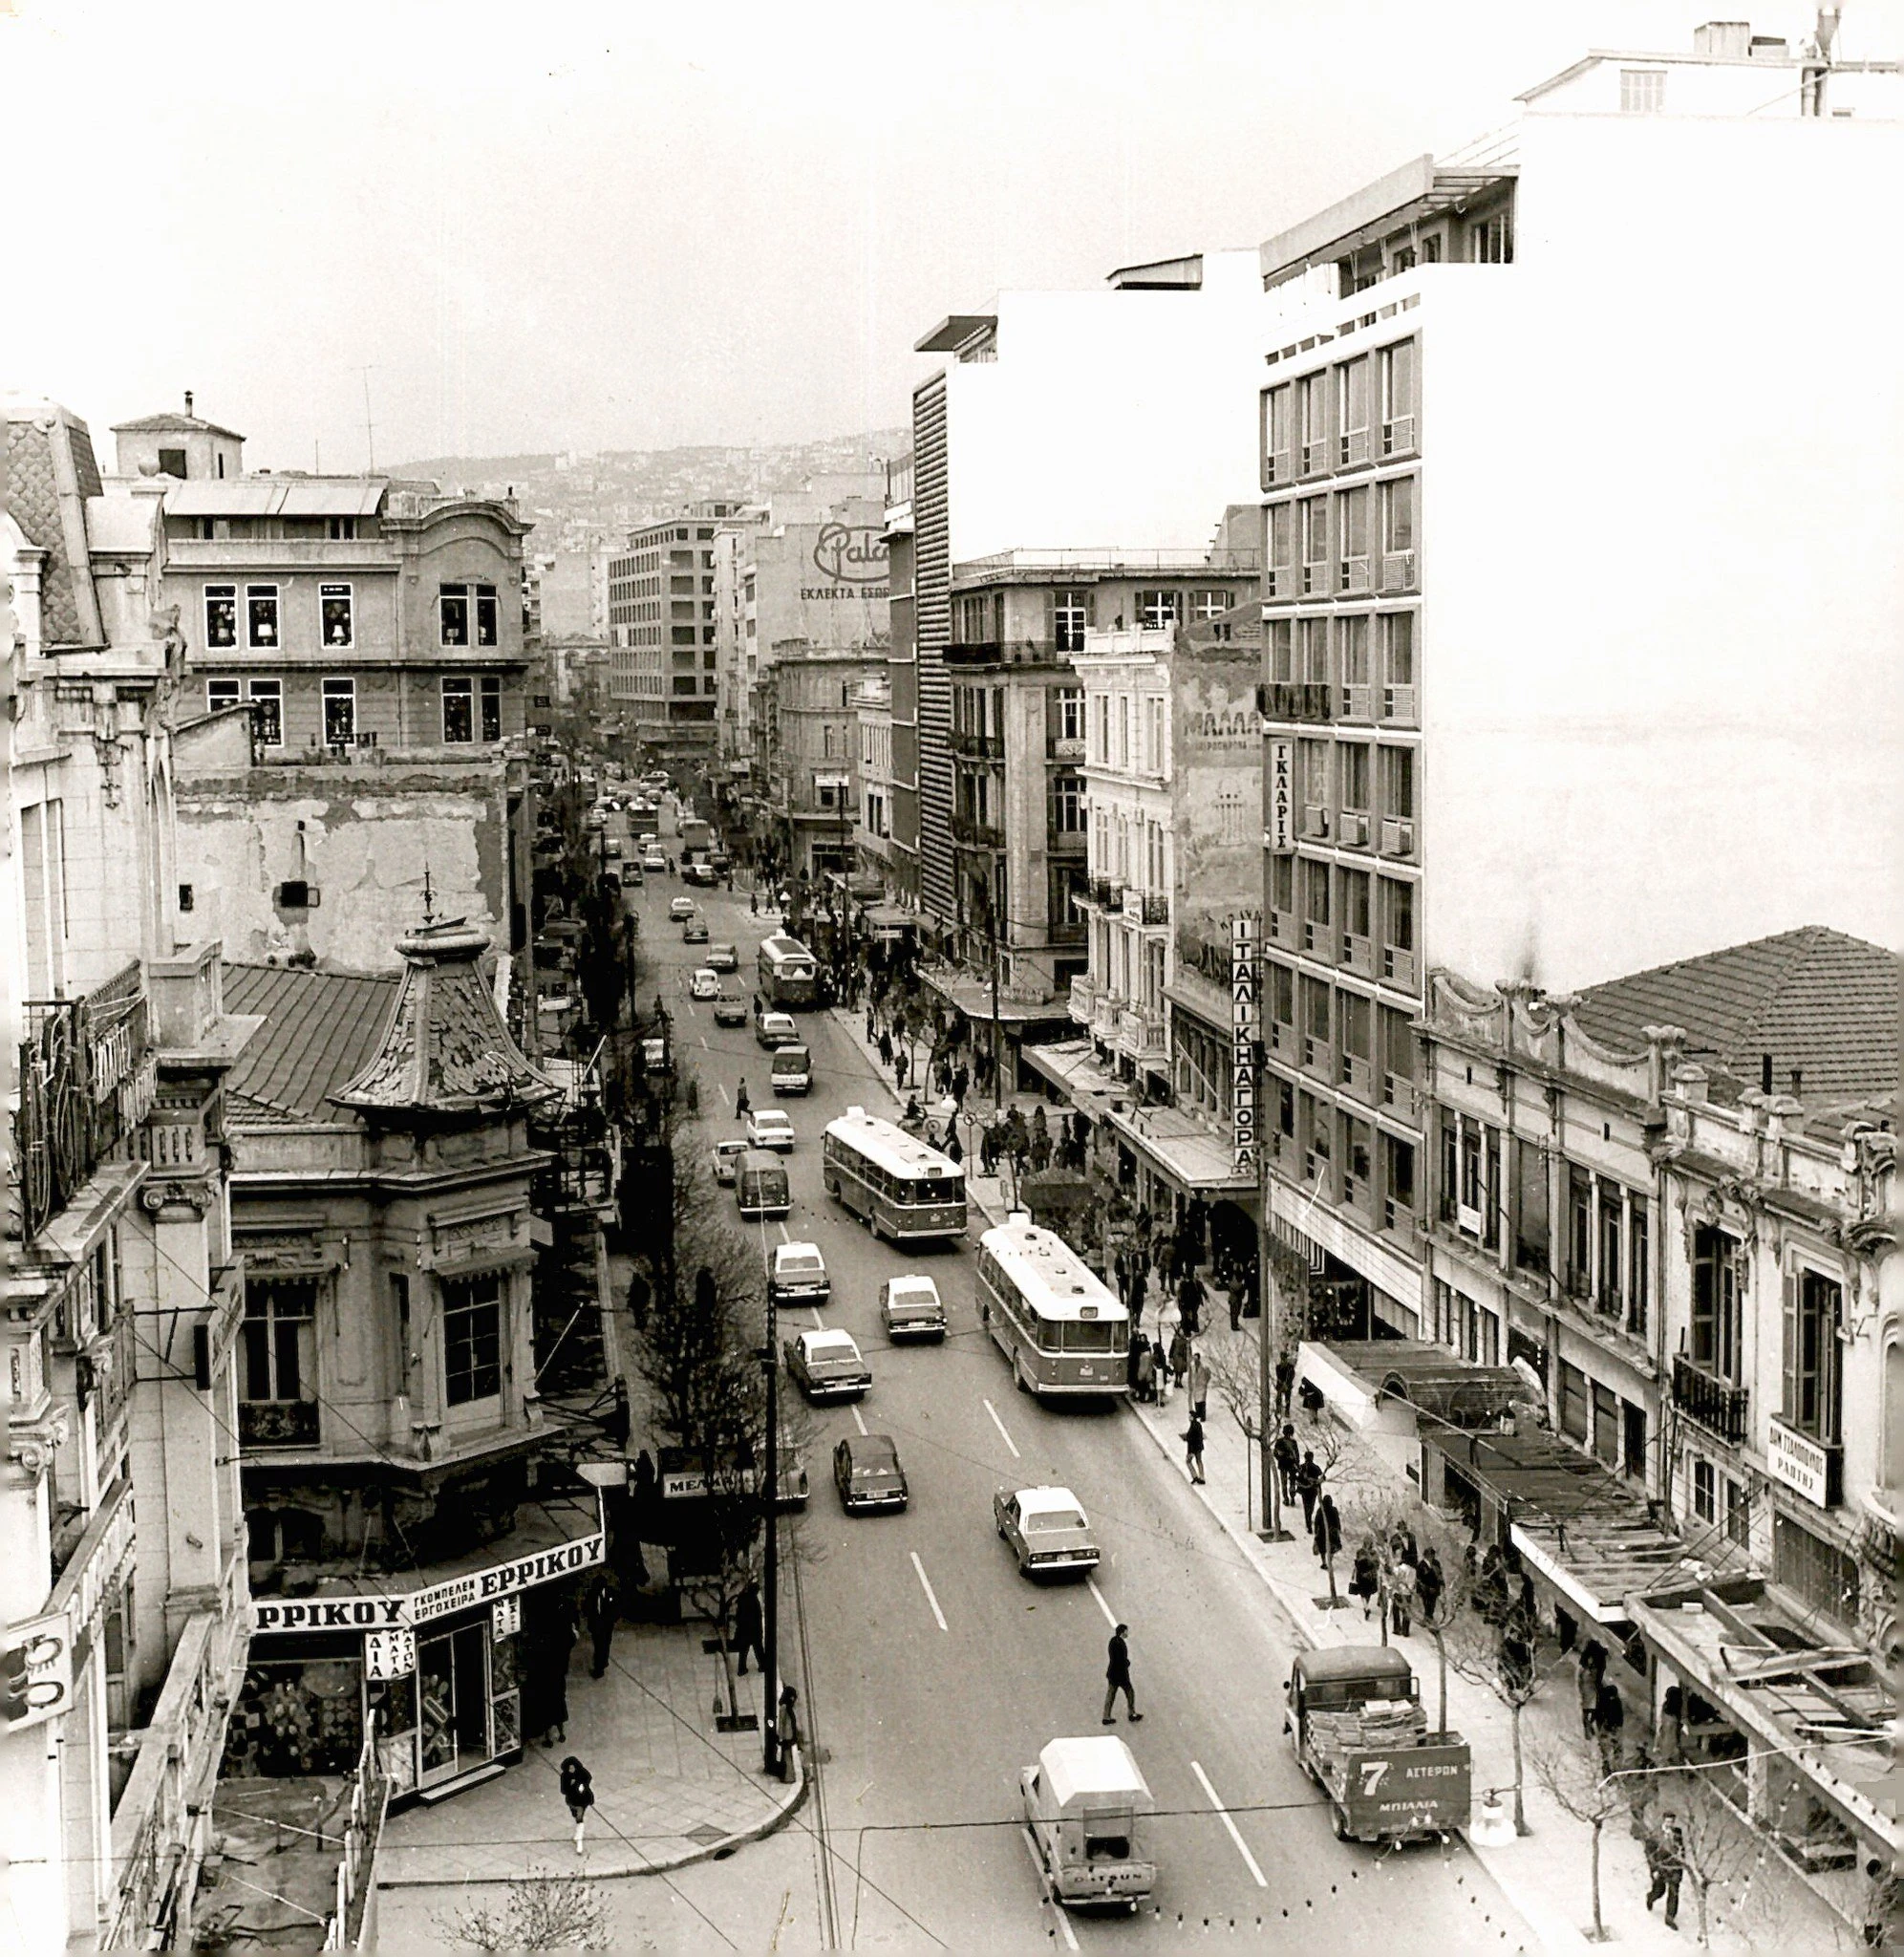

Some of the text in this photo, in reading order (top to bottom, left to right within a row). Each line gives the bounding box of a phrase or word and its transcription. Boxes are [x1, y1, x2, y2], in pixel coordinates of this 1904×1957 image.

[801, 587, 855, 600] ΕΚΛΕΚΤΑ
[1275, 745, 1288, 849] ΓΚΛΑΡΙΣ
[1235, 922, 1252, 1165] ΙΤΑΛΙΚΗ ΑΓΟΡΑ
[1778, 1457, 1813, 1490] ΡΑΠΤΗΣ
[481, 1538, 603, 1597] ΕΡΡΙΚΟΥ
[414, 1579, 475, 1607] ΓΚΟΜΠΕΛΕΝ
[415, 1592, 476, 1621] ΕΡΓΟΧΕΙΡΑ
[370, 1637, 382, 1678] ΔΙΑ
[389, 1634, 399, 1675] ΜΑΤΑ
[1360, 1761, 1389, 1796] 7
[1406, 1765, 1458, 1778] ΑΣΤΕΡΩΝ
